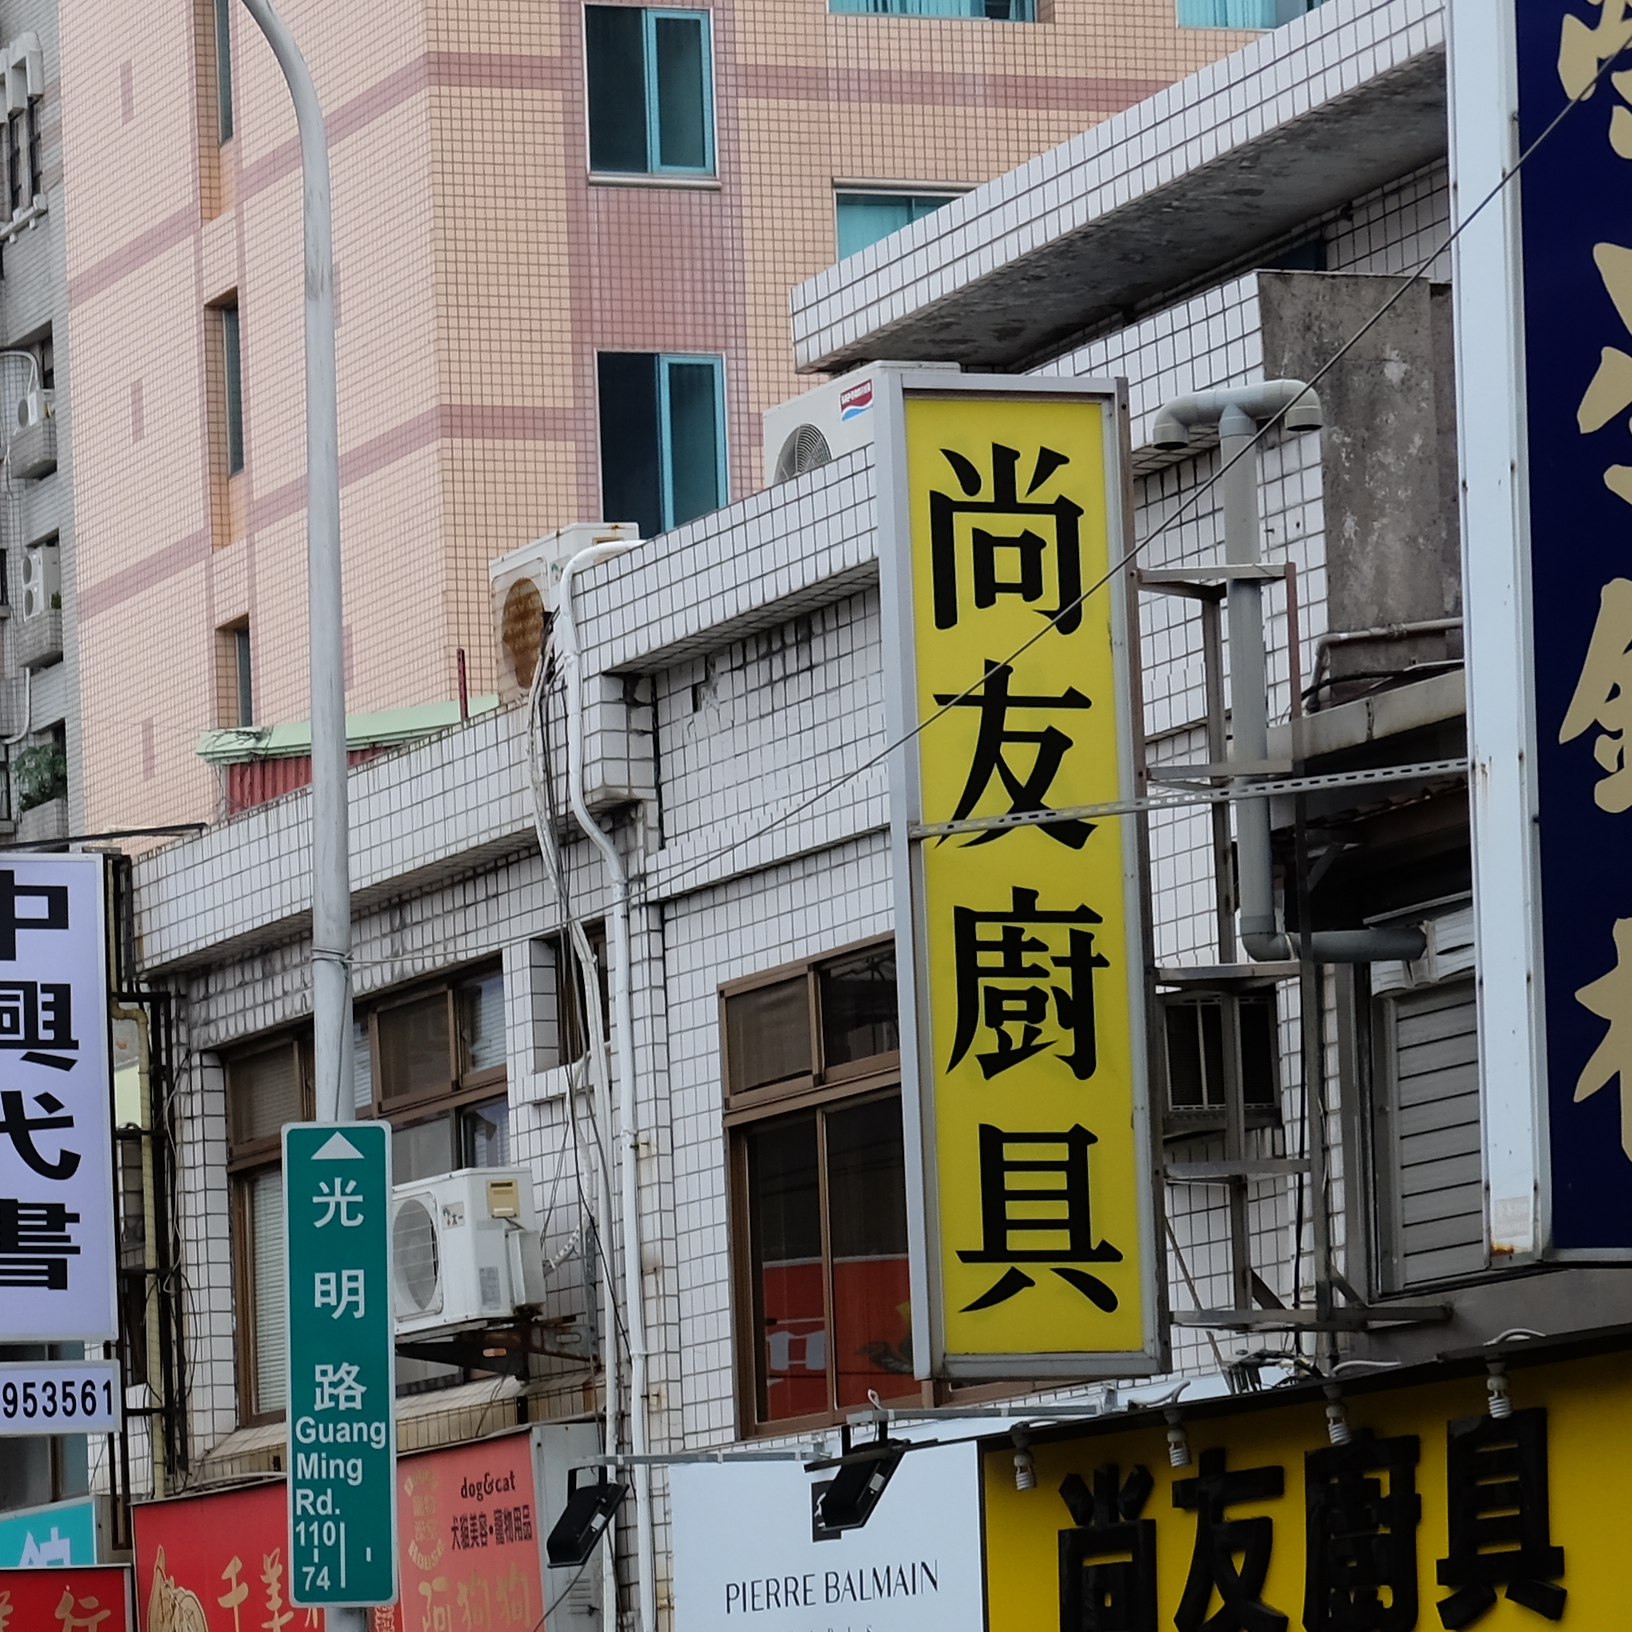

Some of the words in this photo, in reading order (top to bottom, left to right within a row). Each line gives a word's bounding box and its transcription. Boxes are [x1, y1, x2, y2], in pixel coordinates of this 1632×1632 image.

[928, 441, 1123, 1313] 尚友廚具
[312, 1176, 368, 1411] 光明路
[295, 1416, 386, 1448] Guang
[296, 1452, 363, 1486] Ming
[460, 1470, 516, 1501] dog&cat
[295, 1488, 341, 1516] Rd.
[295, 1520, 336, 1547] 110
[302, 1565, 331, 1592] 74
[725, 1573, 817, 1615] PIERRE
[825, 1559, 940, 1604] BALMAIN
